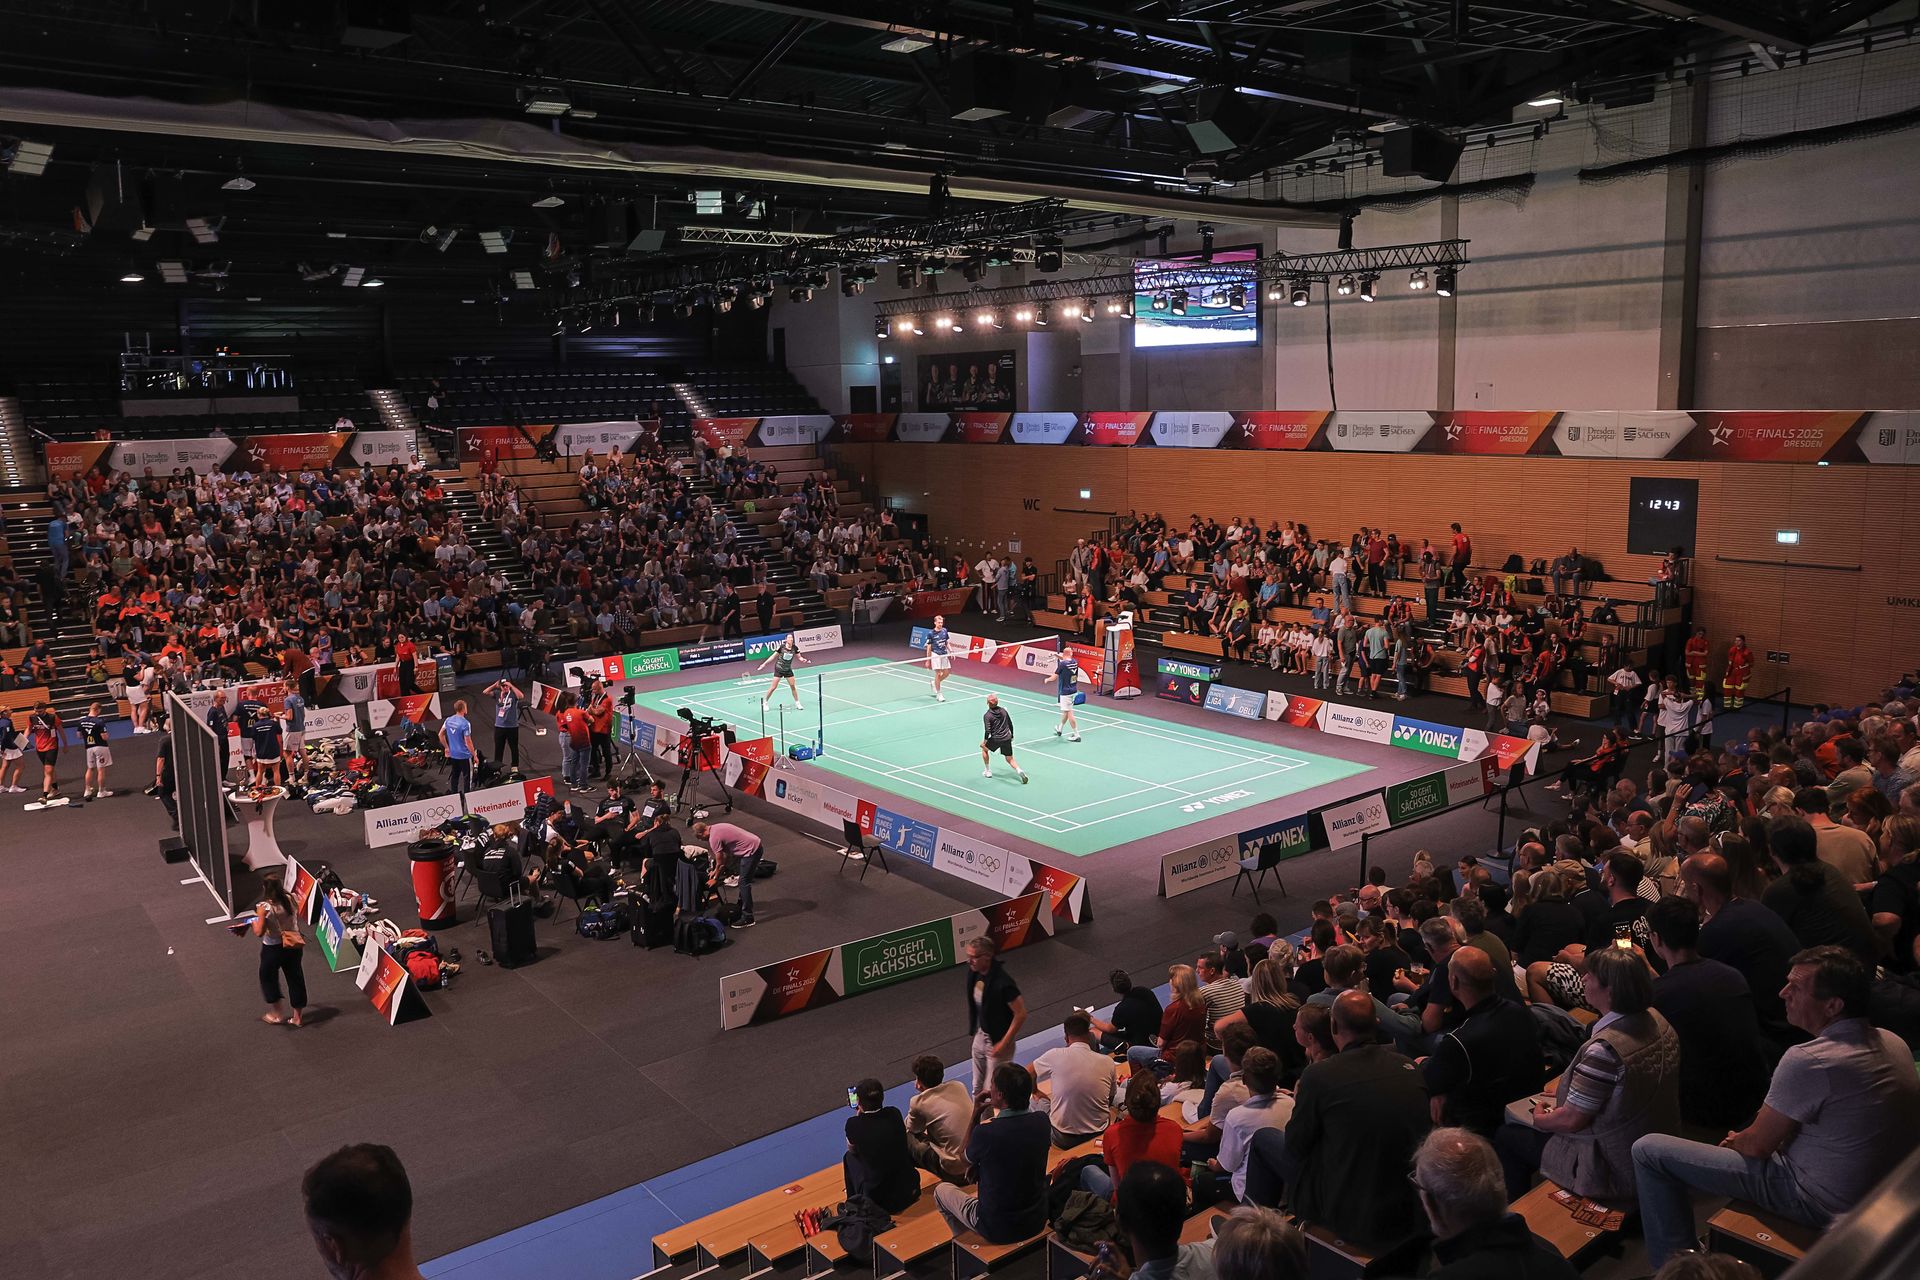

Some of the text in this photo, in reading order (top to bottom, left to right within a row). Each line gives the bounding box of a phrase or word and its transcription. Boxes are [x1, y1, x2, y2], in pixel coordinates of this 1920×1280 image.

[1104, 422, 1123, 430] FINALS
[1123, 422, 1136, 430] 2025
[1292, 424, 1308, 432] 2025
[1465, 426, 1529, 435] DIE FINALS 2025
[1499, 435, 1529, 443] DRESDEN
[1637, 431, 1671, 439] SACHSEN
[1737, 428, 1824, 439] DIE FINALS 2025
[495, 437, 519, 445] FINALS
[1783, 440, 1823, 448] DRESDEN
[282, 446, 310, 455] FINALS
[311, 445, 329, 453] 2025
[60, 455, 83, 464] 2025
[1023, 498, 1040, 511] WC
[417, 669, 437, 680] 2025
[1178, 664, 1201, 677] YONEX
[1206, 696, 1222, 706] LIGA
[1238, 706, 1256, 716] DBLV
[1331, 713, 1354, 724] Allianz
[1418, 728, 1458, 750] YONEX
[1202, 789, 1255, 805] YONEX
[1410, 784, 1433, 799] SO GEHT
[787, 793, 803, 804] ticker
[473, 799, 522, 815] Miteinander.
[823, 801, 853, 820] Miteinander.
[375, 816, 409, 830] Allianz
[875, 817, 893, 830] BUNDES
[1332, 817, 1356, 831] Allianz
[874, 825, 891, 841] LIGA
[910, 843, 930, 860] DBLV
[941, 842, 965, 859] Allianz
[1171, 860, 1198, 876] Allianz
[1002, 920, 1019, 930] FINALS
[882, 938, 926, 960] SO GEHT
[863, 948, 937, 980] SÄCHSISCH.
[782, 981, 803, 992] FINALS
[802, 976, 816, 986] 2025
